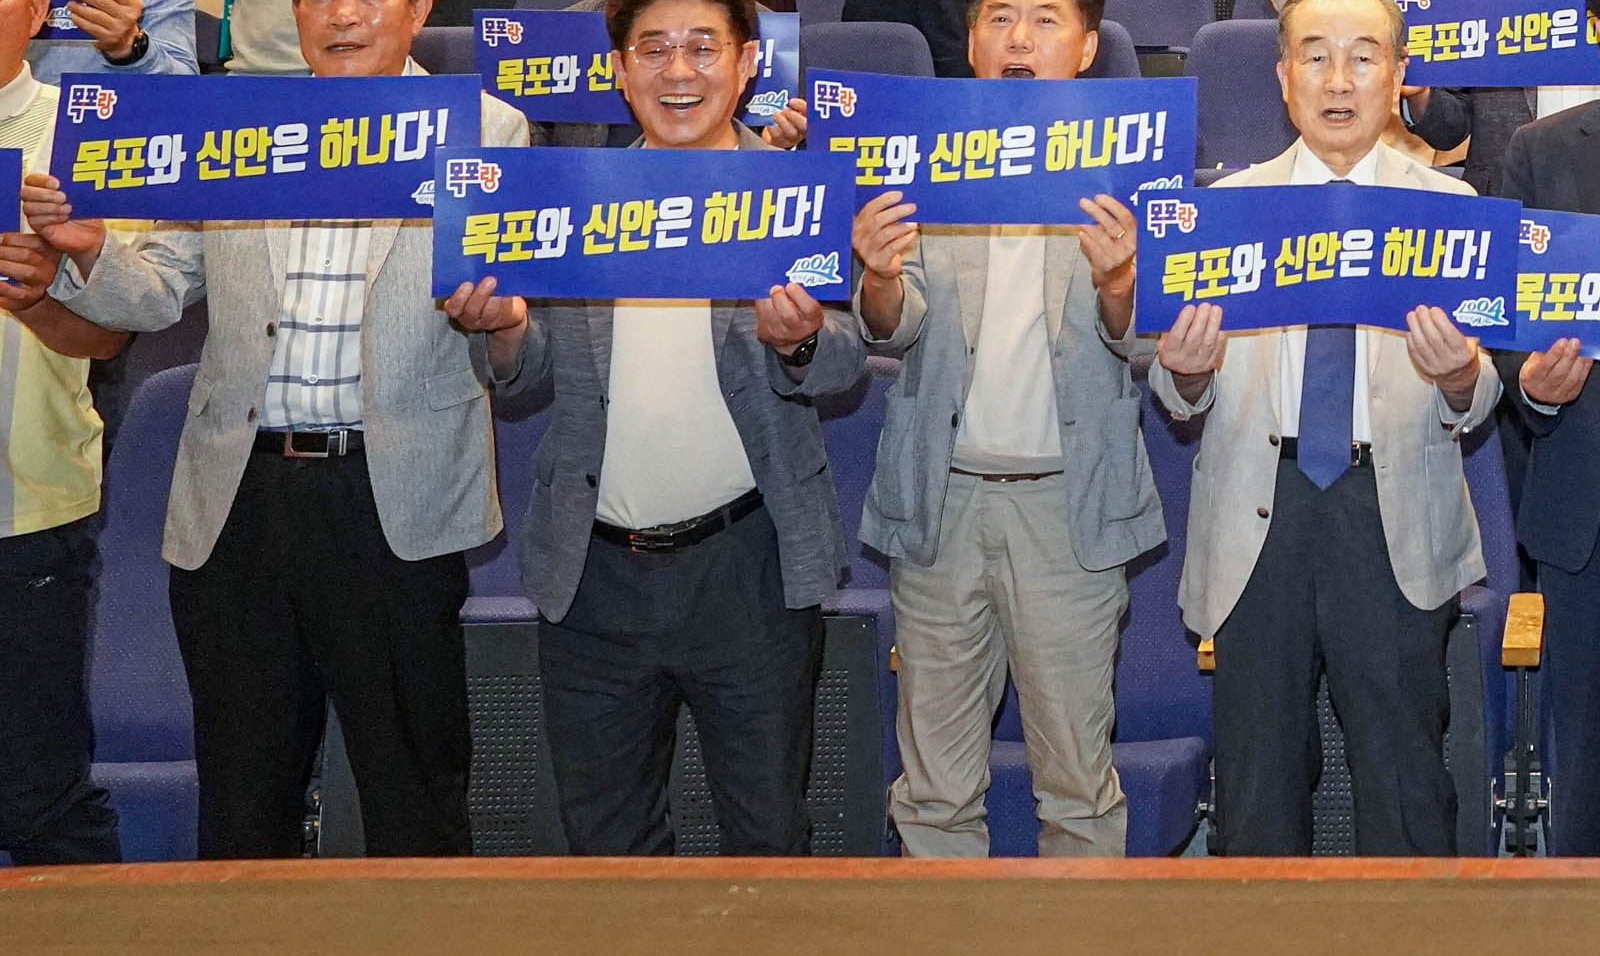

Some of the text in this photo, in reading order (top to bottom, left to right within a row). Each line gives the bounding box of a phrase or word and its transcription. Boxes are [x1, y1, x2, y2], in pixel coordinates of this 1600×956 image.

[1403, 19, 1489, 63] 목포와
[1496, 9, 1578, 55] 신안은
[496, 55, 581, 96] 목포와
[72, 108, 449, 190] 목포와 신안은 하나다!
[830, 111, 1167, 185] 포와 신안은 하나다!
[462, 185, 825, 263] 목포와 신안은 하나다!
[1519, 221, 1550, 253] 포랑
[1162, 227, 1491, 301] 목포와 신안은 하나다!
